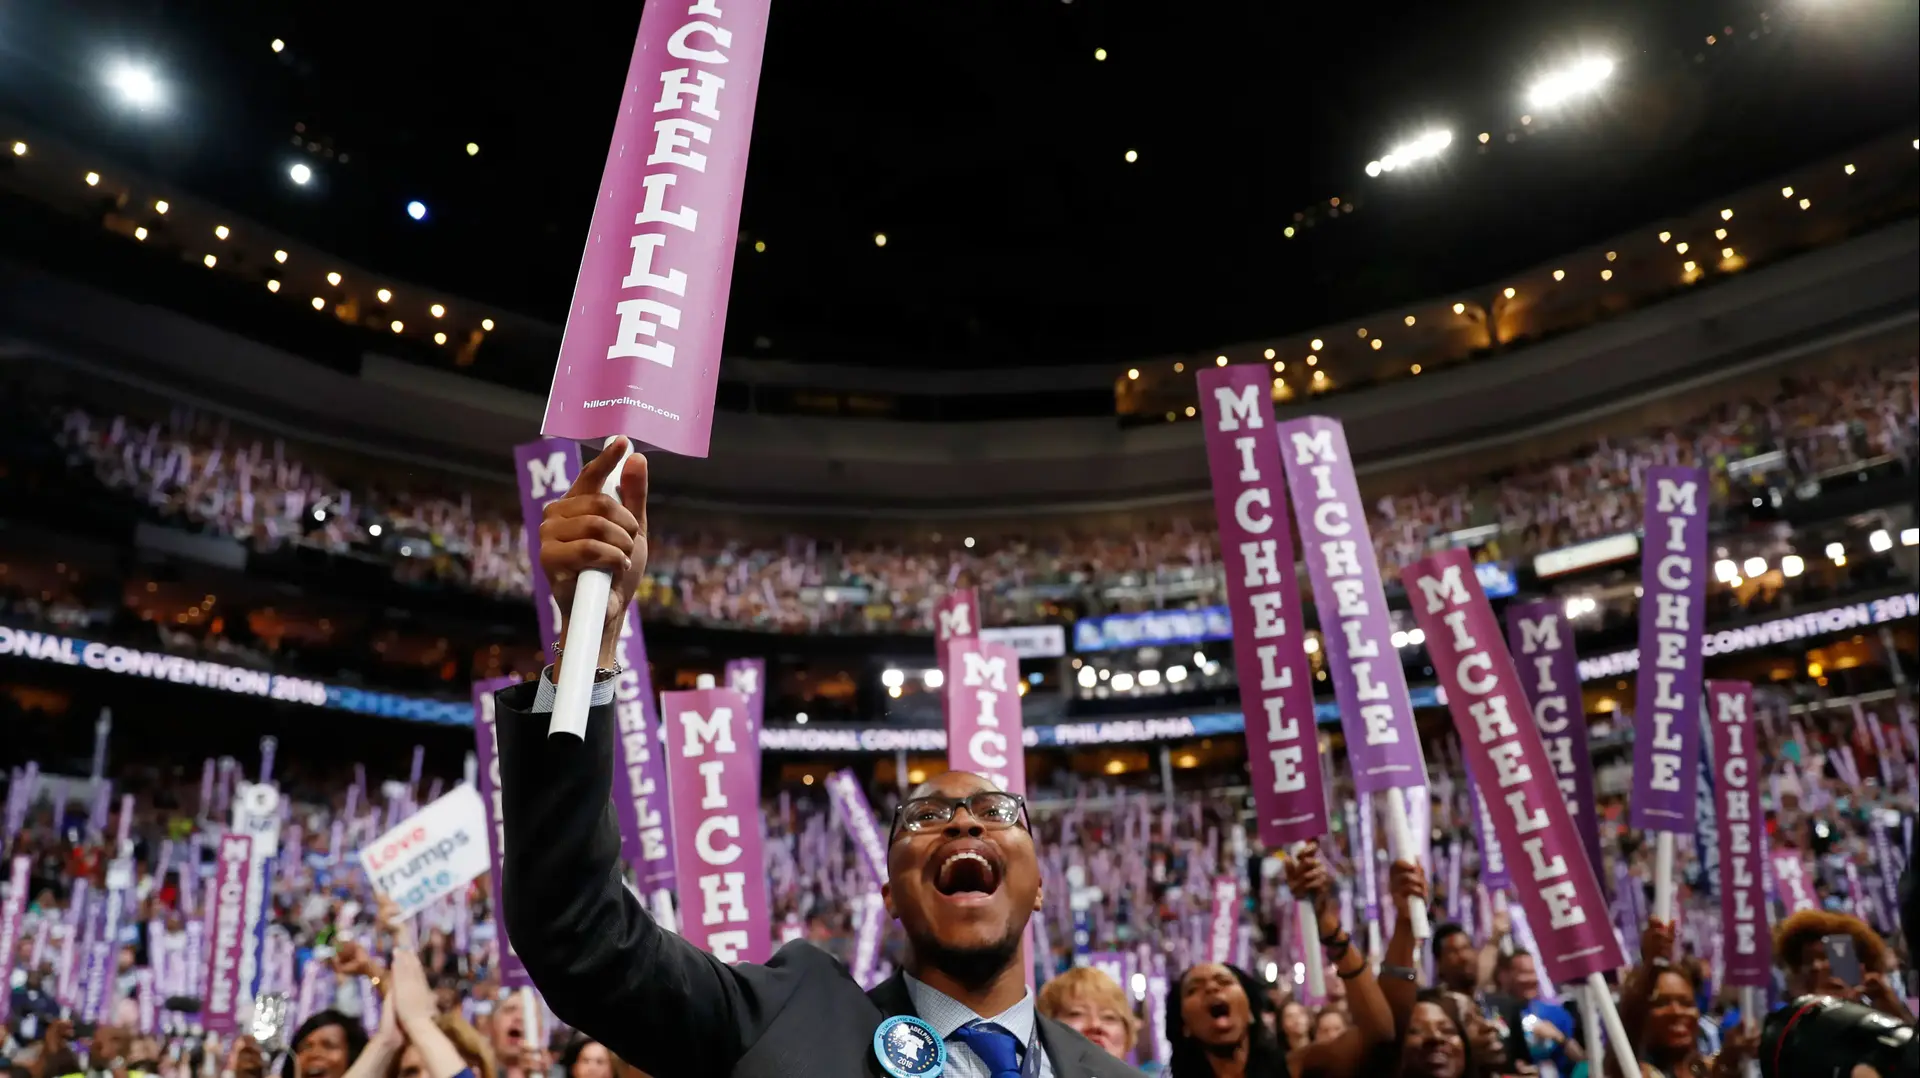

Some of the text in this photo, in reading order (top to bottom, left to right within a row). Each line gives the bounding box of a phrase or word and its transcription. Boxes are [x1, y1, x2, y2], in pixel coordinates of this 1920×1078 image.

[583, 396, 680, 421] hillaryclinton.com
[1213, 384, 1306, 794] MICHELLE
[1291, 429, 1401, 747] MICHELLE
[1649, 478, 1699, 793] MICHELLE
[82, 641, 271, 697] CONVENTION
[270, 674, 328, 706] 2016
[759, 727, 859, 750] NATIONAL
[1055, 717, 1196, 745] PHILADELPHIA
[1416, 564, 1588, 931] MICHELLE
[368, 827, 426, 870] Love
[1716, 691, 1756, 955] MICHELLE
[377, 830, 470, 893] trumps
[898, 1056, 913, 1069] 2016
